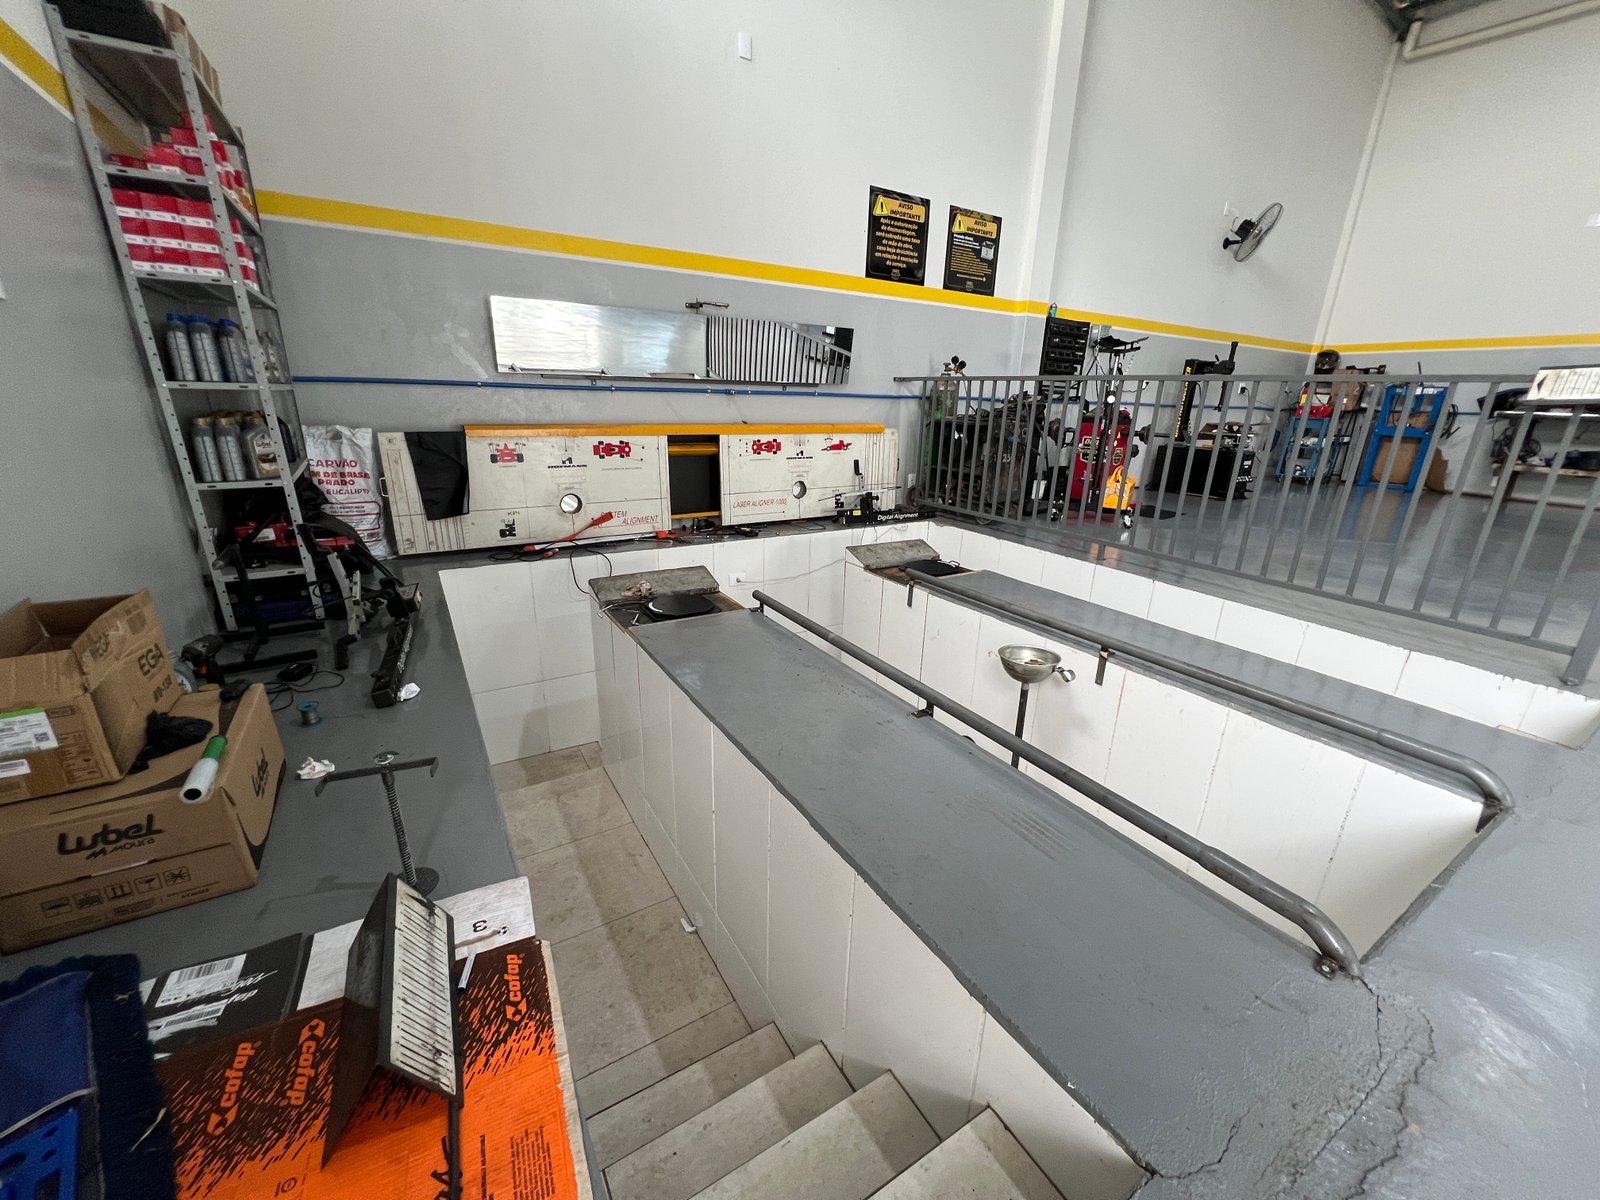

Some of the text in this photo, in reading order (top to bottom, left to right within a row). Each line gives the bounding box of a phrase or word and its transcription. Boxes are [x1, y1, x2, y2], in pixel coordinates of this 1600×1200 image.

[898, 202, 913, 210] AVISO
[889, 208, 920, 221] IMPORTANTE
[966, 226, 992, 236] IMPORTANTE
[322, 471, 337, 479] DE
[339, 471, 370, 480] BRASA
[317, 478, 356, 486] PRADO
[734, 500, 754, 509] LASER
[622, 515, 659, 525] ALIGNMENT
[894, 512, 919, 520] Alignment
[138, 642, 164, 677] EGA
[250, 746, 269, 798] Lubel
[57, 813, 166, 855] Lubel
[506, 952, 524, 1002] cofap
[221, 1041, 257, 1108] cofap
[287, 1039, 317, 1106] cofap
